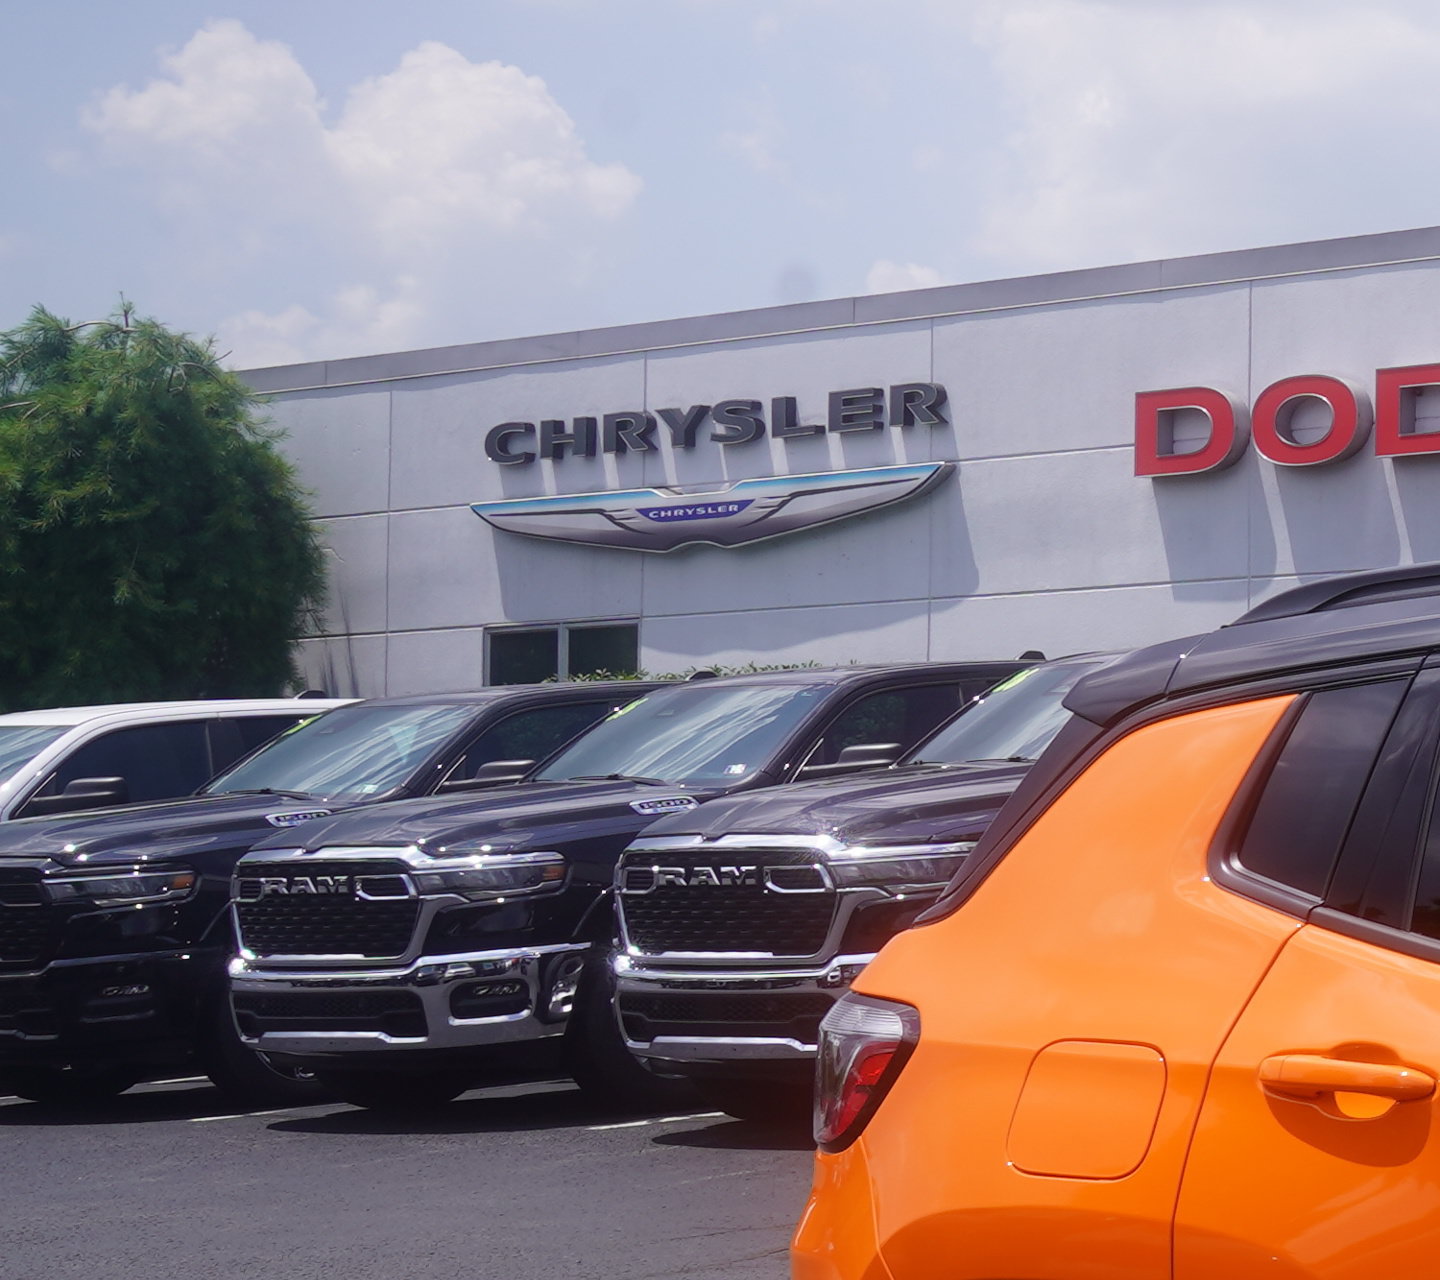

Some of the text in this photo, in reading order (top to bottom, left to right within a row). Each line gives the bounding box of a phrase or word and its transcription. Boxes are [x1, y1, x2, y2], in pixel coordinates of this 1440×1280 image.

[484, 381, 950, 466] CHRYSLER
[648, 504, 739, 519] CHRYSLER
[640, 798, 690, 810] 1500
[261, 875, 349, 895] RAM
[653, 865, 757, 887] RAM
